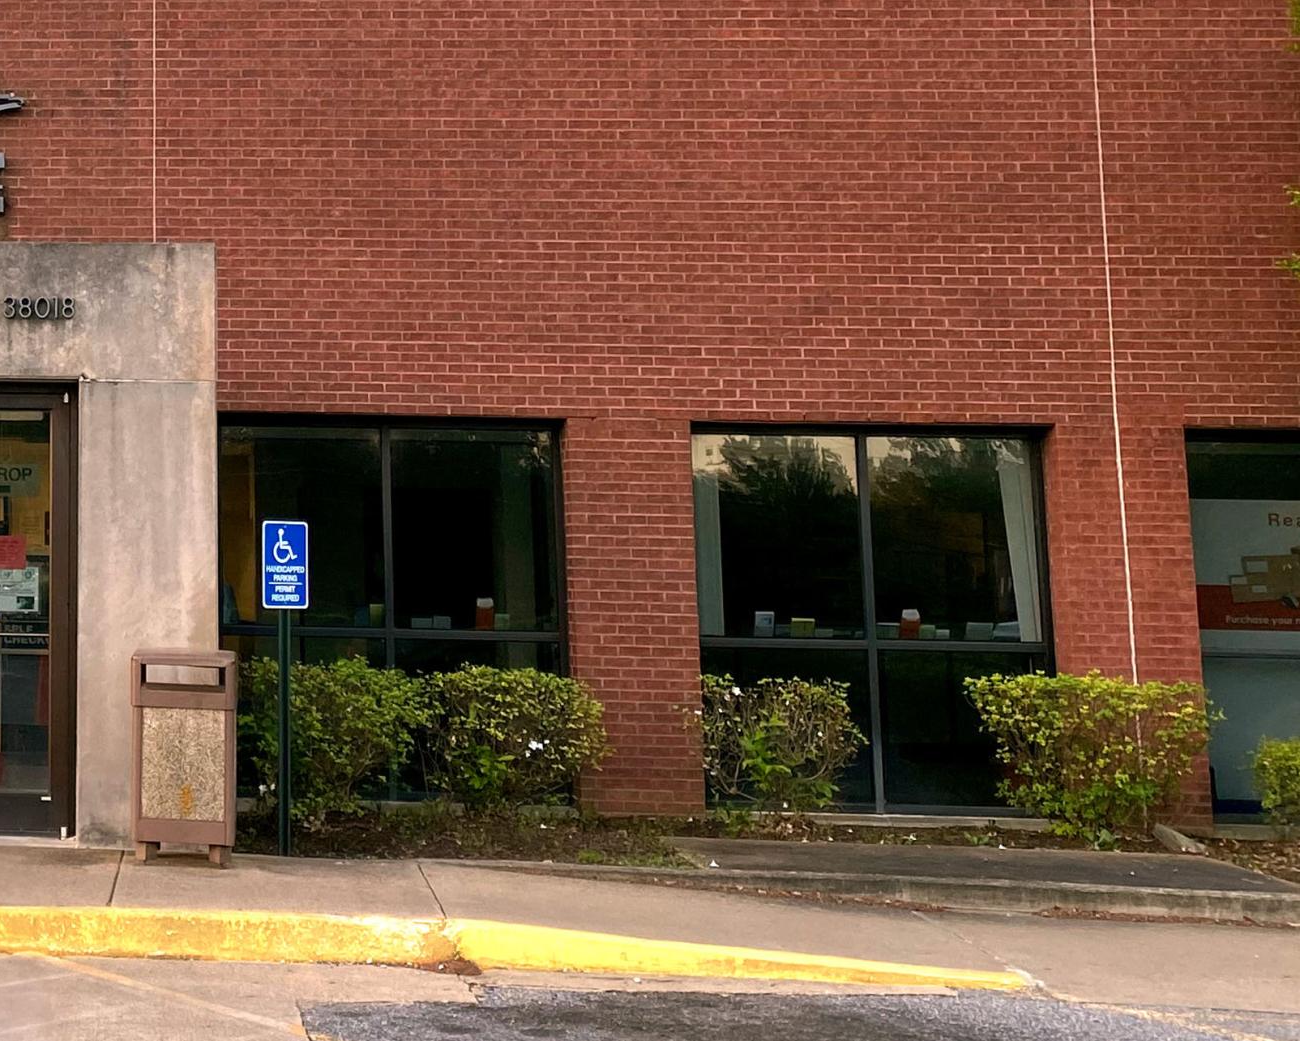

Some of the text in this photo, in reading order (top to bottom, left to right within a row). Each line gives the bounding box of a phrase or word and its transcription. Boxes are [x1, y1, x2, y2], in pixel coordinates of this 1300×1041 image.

[2, 296, 76, 320] 38018
[266, 564, 305, 573] HANDICAPPED
[273, 574, 298, 582] PARKING
[275, 585, 296, 593] PERMIT
[271, 594, 300, 602] REQUIRED
